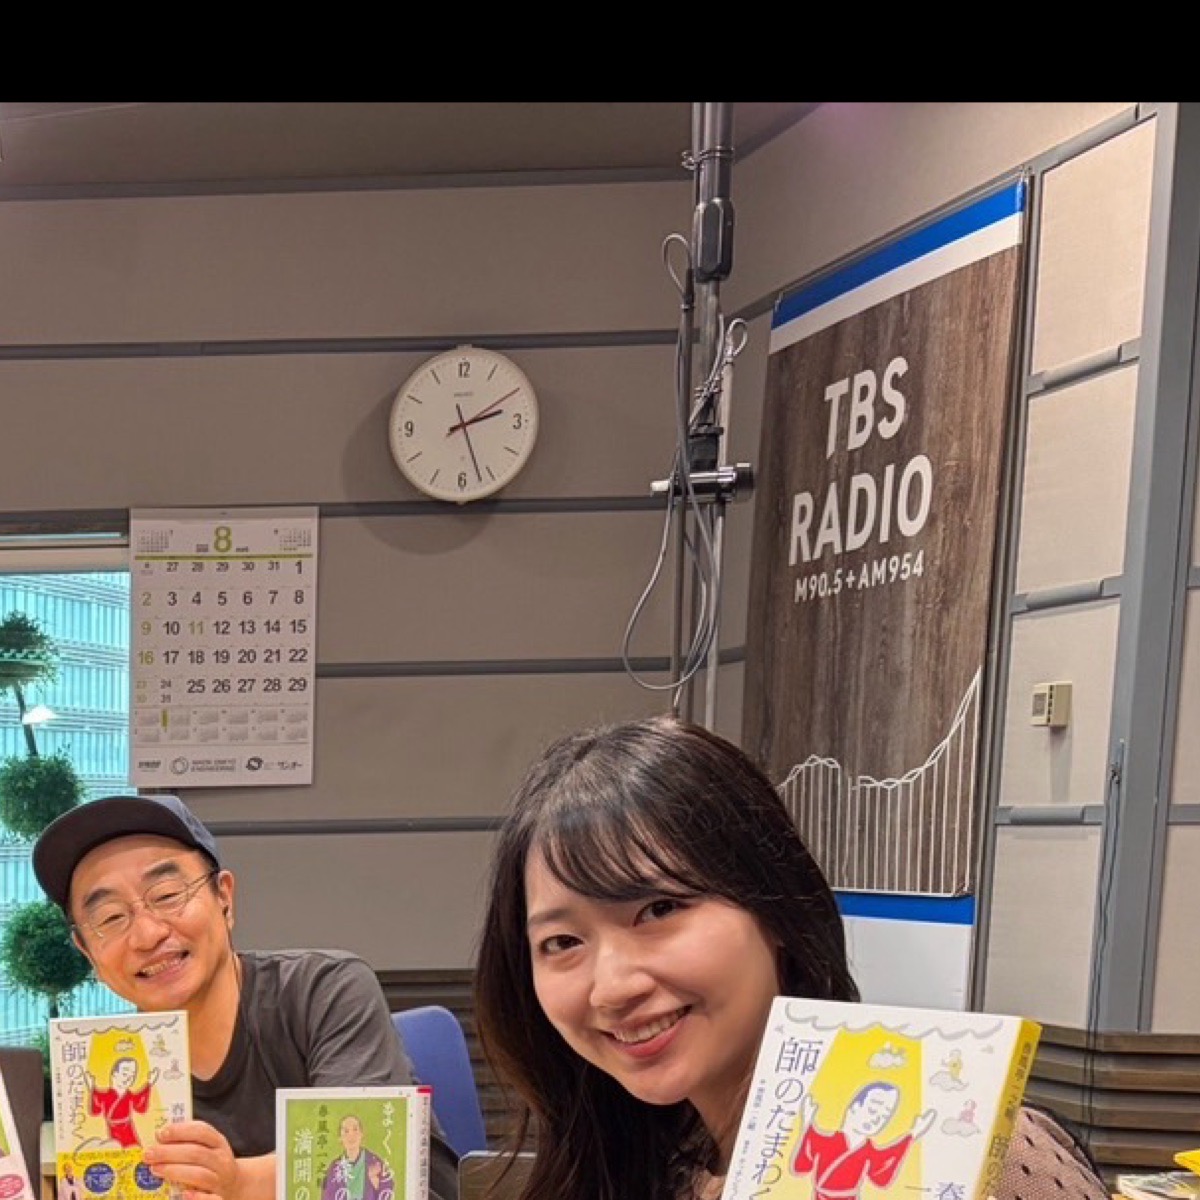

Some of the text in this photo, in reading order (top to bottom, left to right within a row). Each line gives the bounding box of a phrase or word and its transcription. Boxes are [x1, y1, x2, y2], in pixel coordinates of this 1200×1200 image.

[457, 361, 471, 378] 12
[824, 356, 909, 460] TBS
[404, 421, 414, 438] 9
[512, 413, 522, 430] 3
[457, 472, 467, 488] 6
[788, 454, 933, 567] RADIO
[214, 526, 232, 553] 8
[295, 561, 303, 574] 1
[142, 590, 304, 606] 2 3 4 5 6 7 8
[141, 619, 307, 635] 9 10 11 12 13 14 15
[139, 649, 308, 665] 16 17 18 19 20 21 22
[187, 679, 206, 693] 25
[212, 679, 231, 693] 26
[238, 679, 256, 693] 27
[263, 678, 282, 692] 28
[288, 678, 307, 692] 29
